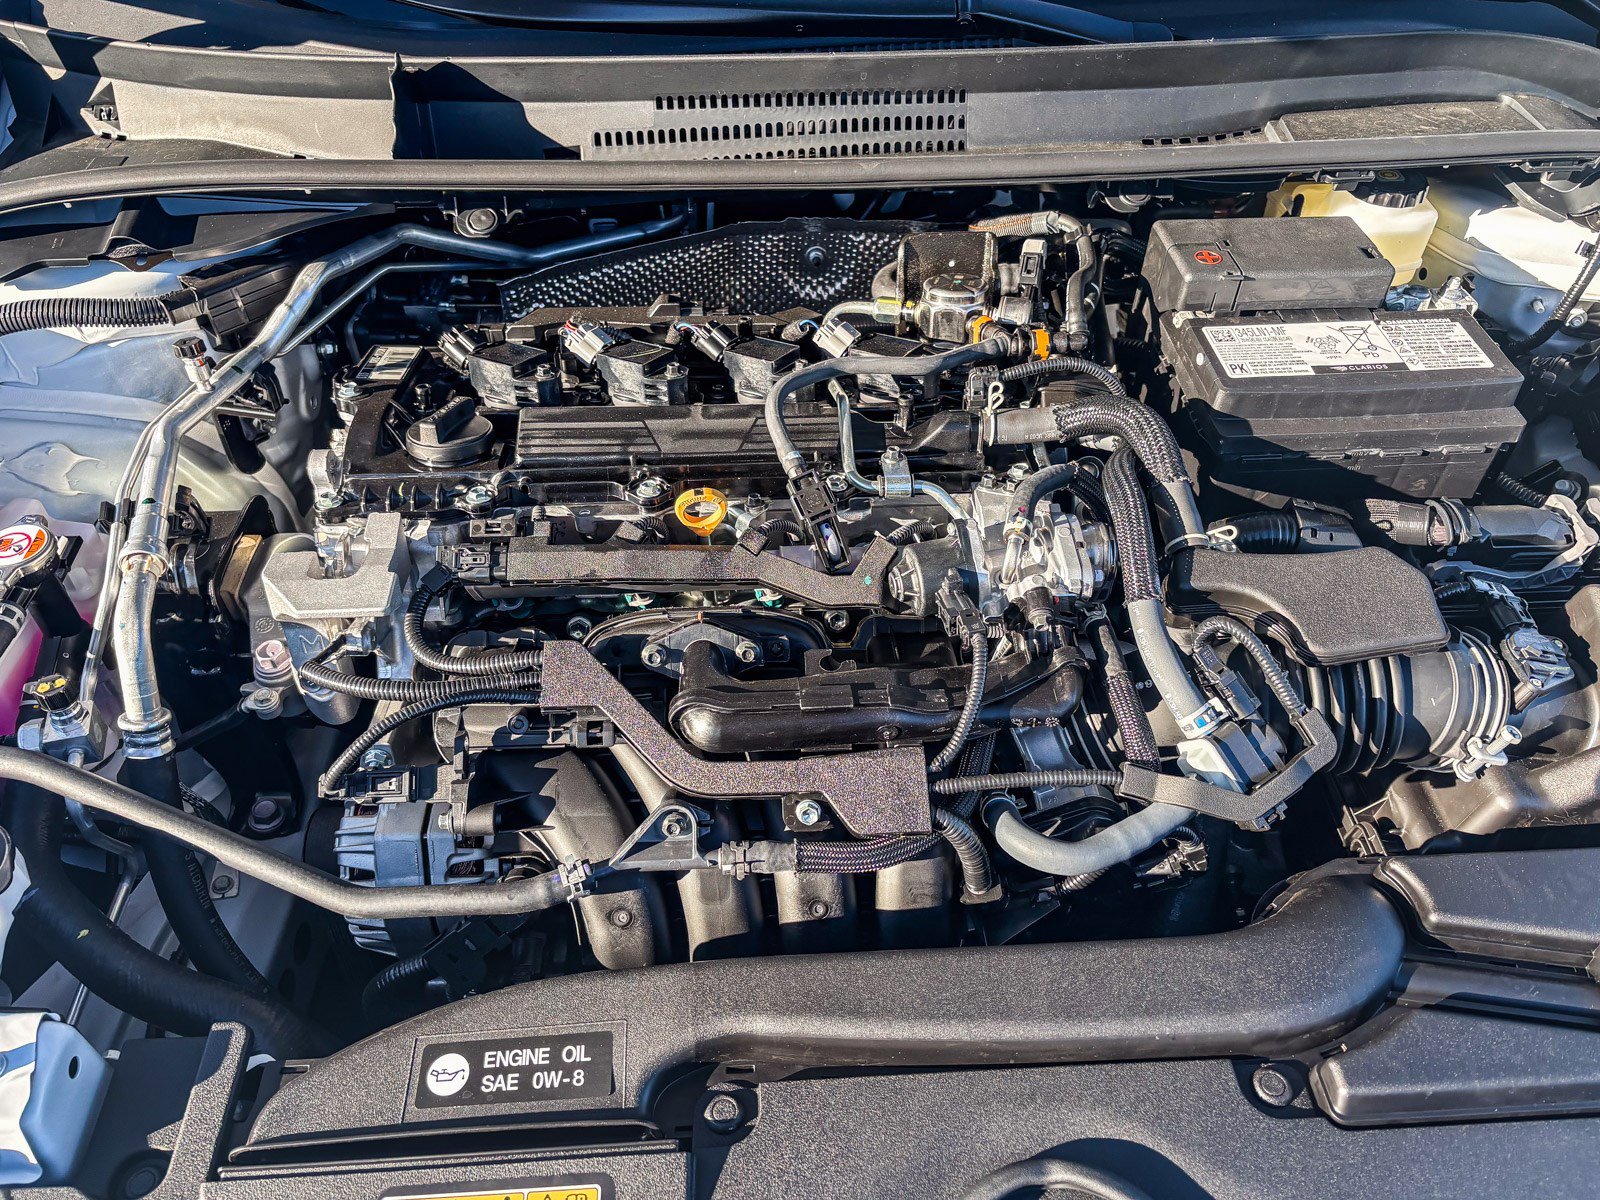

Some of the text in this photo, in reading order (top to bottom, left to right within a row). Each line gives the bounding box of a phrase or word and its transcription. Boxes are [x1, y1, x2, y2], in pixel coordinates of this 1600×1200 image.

[1234, 326, 1287, 338] 345LN1-MF
[1229, 363, 1249, 374] PK
[1348, 363, 1389, 371] CLARIOS
[483, 1044, 592, 1069] ENGINE OIL
[480, 1069, 585, 1093] SAE 0W-8
